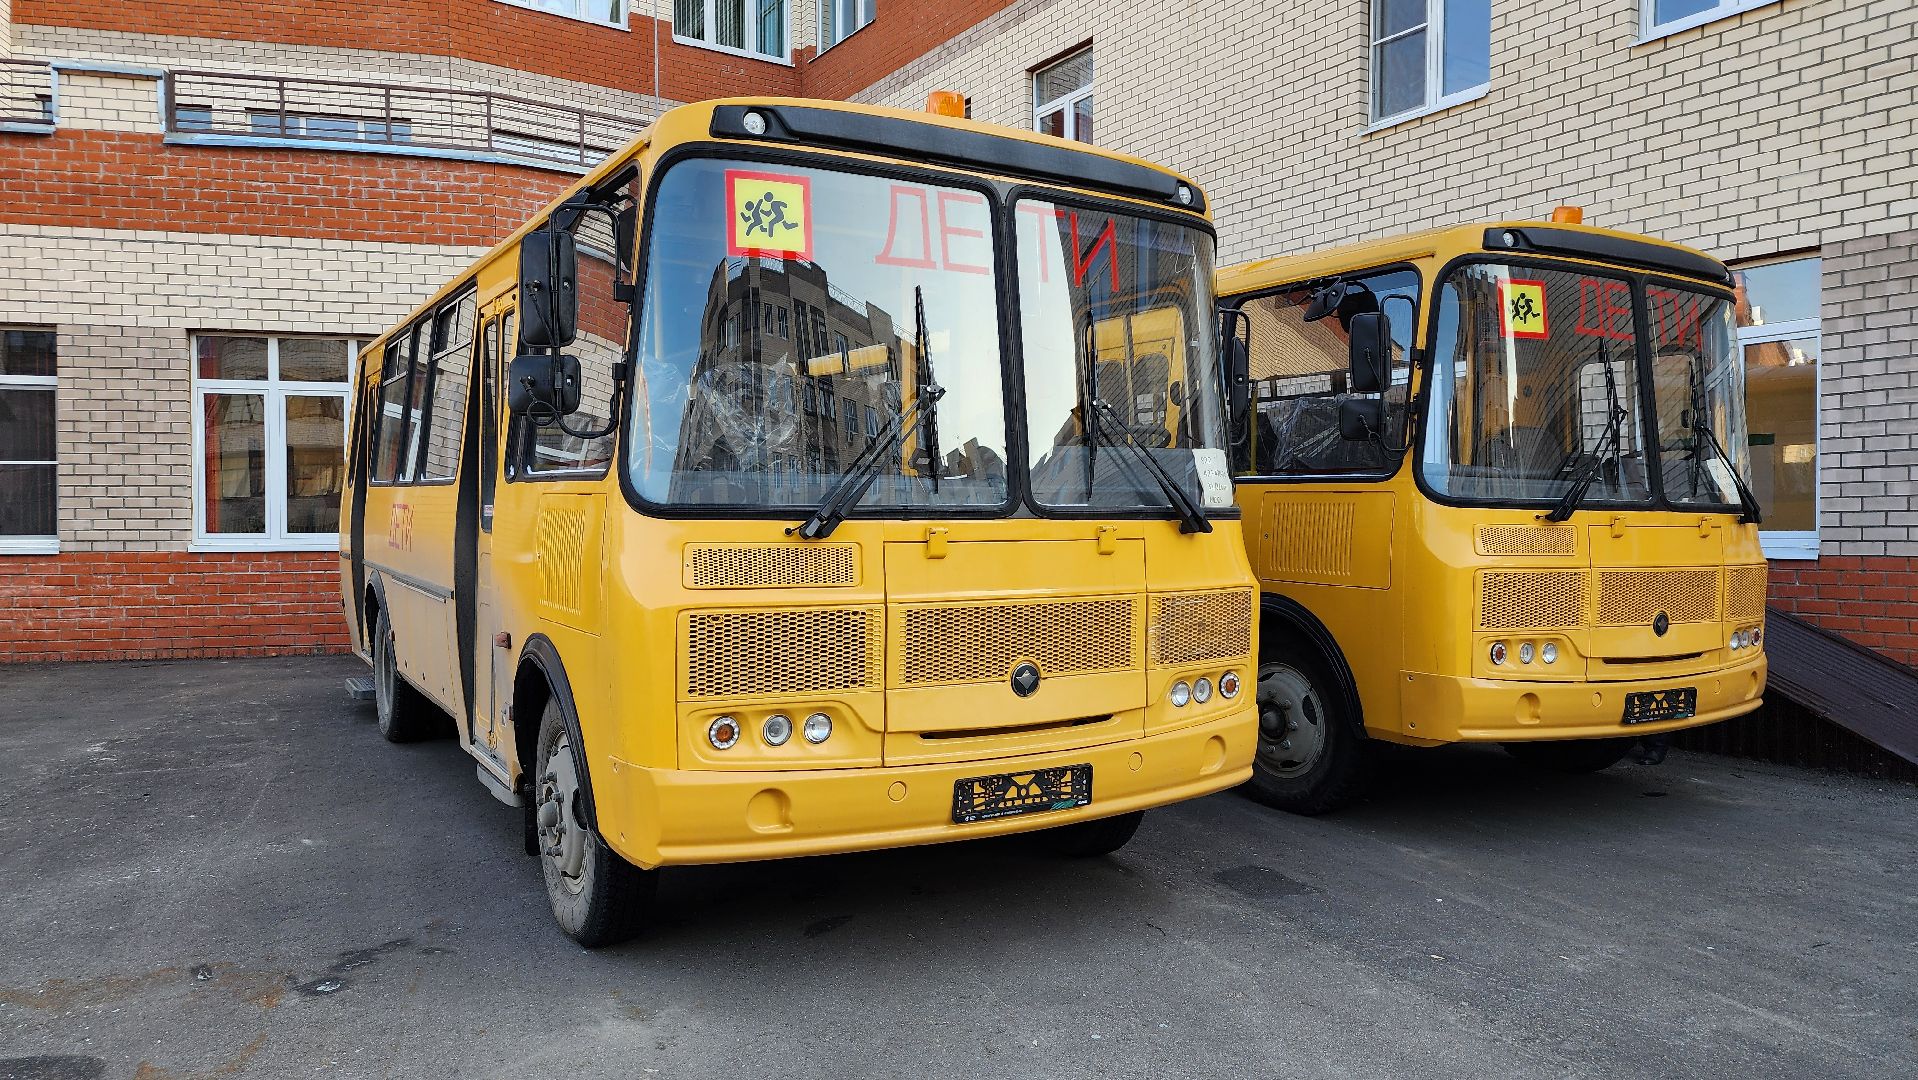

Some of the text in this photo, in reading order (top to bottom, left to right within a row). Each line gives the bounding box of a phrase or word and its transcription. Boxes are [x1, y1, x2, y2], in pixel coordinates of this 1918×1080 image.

[875, 185, 1120, 292] ДЕТИ
[1575, 278, 1702, 352] ДЕТИ
[388, 503, 415, 552] ДЕТИ
